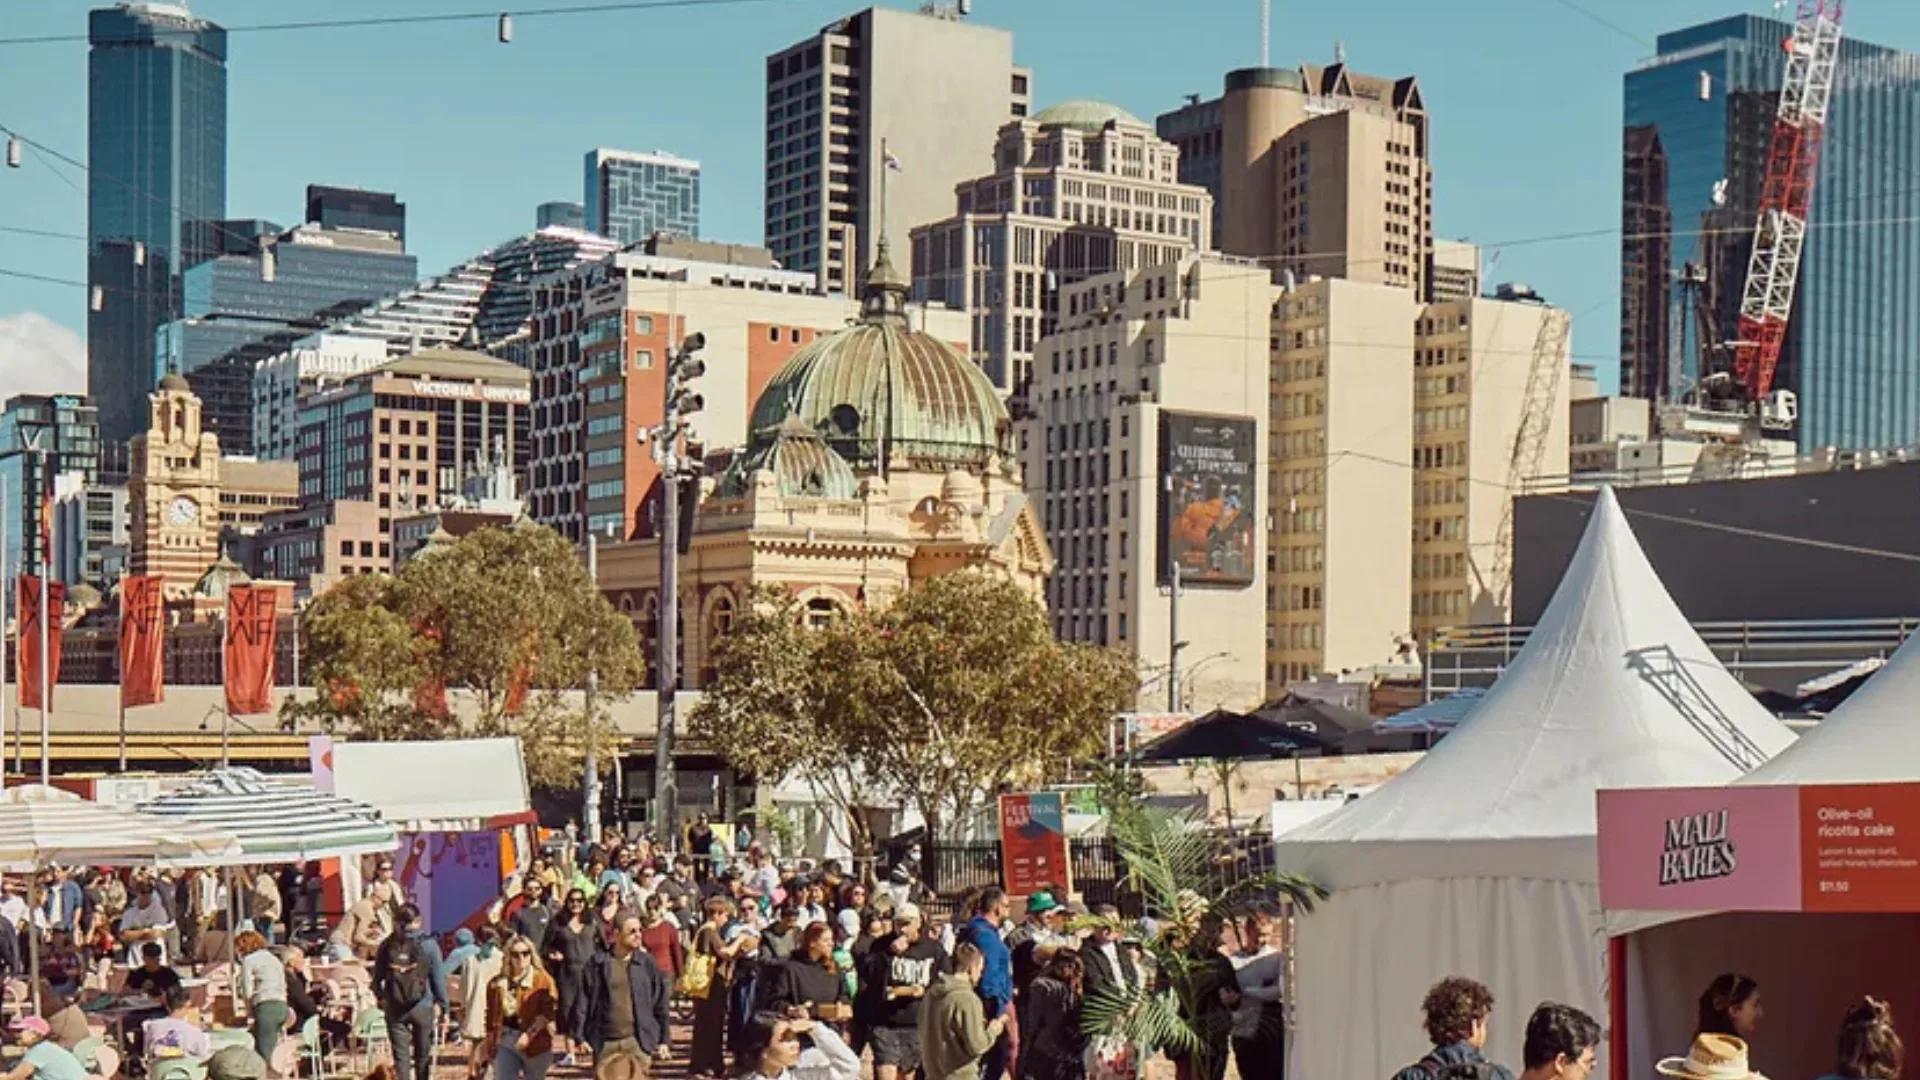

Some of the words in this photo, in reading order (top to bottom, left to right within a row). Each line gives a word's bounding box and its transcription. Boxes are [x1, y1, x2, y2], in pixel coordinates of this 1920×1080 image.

[412, 380, 472, 397] VICTORIA
[228, 586, 276, 617] MF
[1005, 803, 1057, 816] FESTIVAL
[1005, 815, 1030, 827] BAR
[1665, 809, 1728, 851] MALI
[1817, 823, 1860, 837] ricotta
[1863, 823, 1895, 837] cake
[1659, 841, 1737, 886] BAKES
